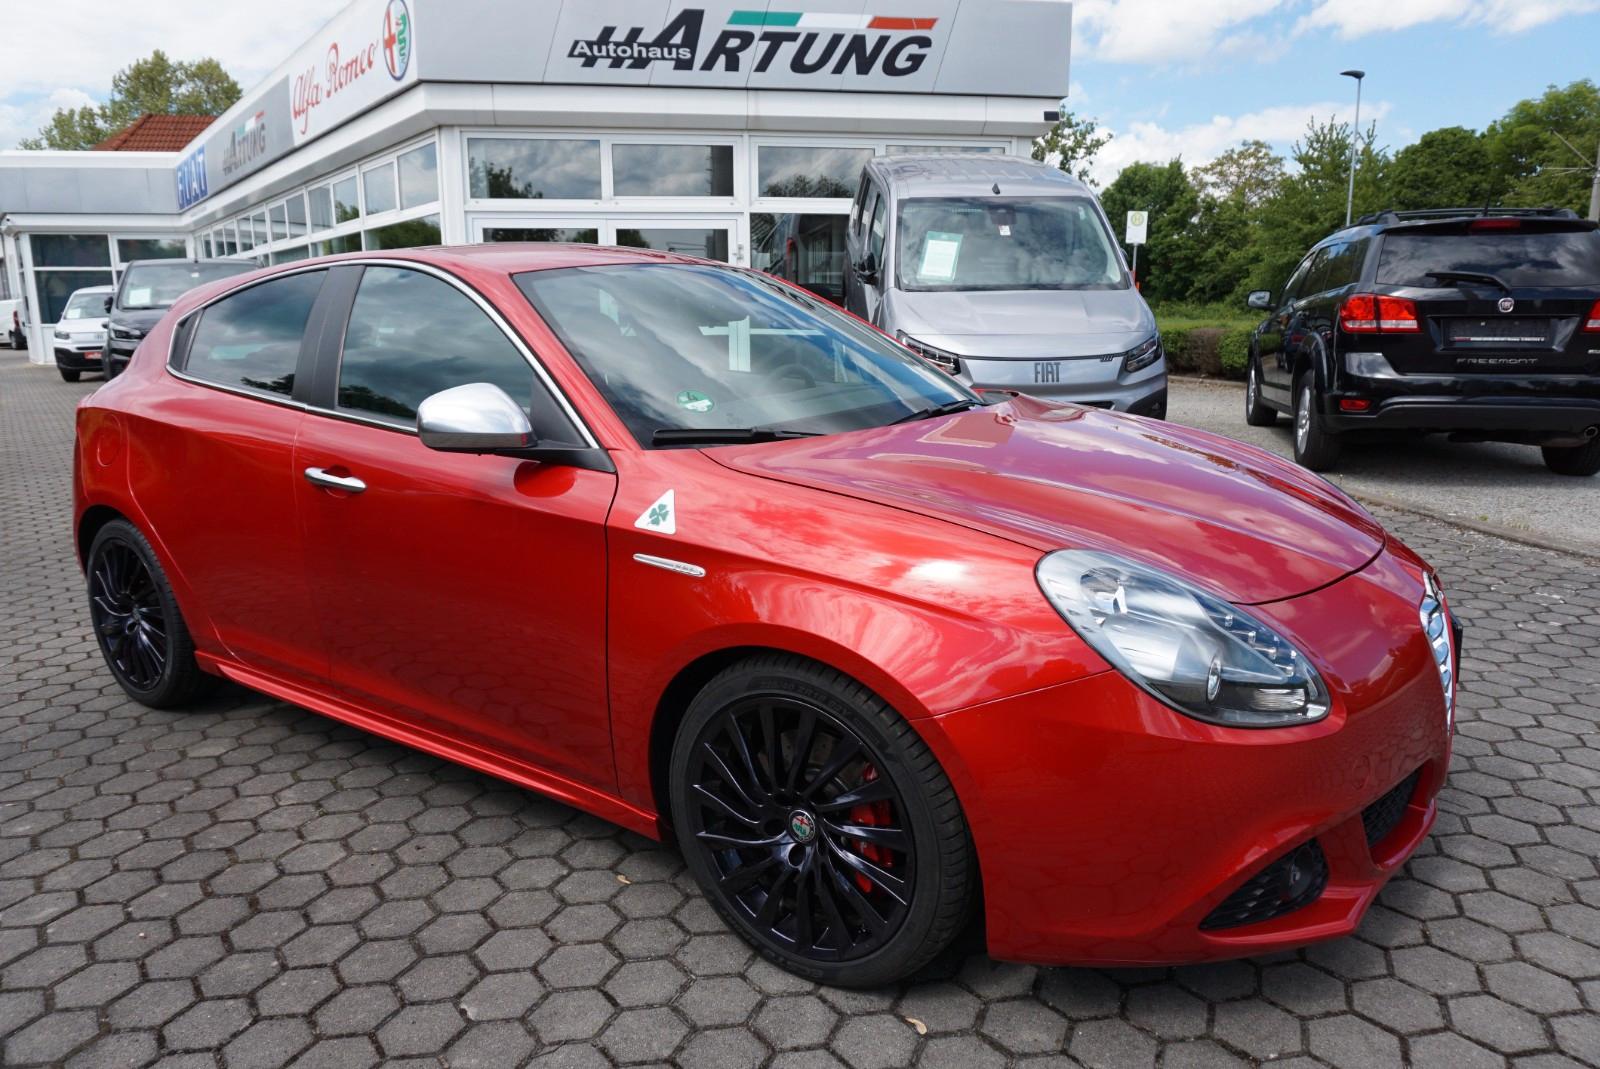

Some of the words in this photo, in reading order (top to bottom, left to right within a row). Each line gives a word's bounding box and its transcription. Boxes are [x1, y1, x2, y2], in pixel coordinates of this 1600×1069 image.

[572, 39, 693, 61] Autohaus
[292, 65, 322, 136] Alfa
[325, 40, 378, 97] Romeo
[177, 150, 207, 207] FIAT
[1034, 361, 1061, 383] FIAT
[1456, 357, 1539, 365] FREEMONT
